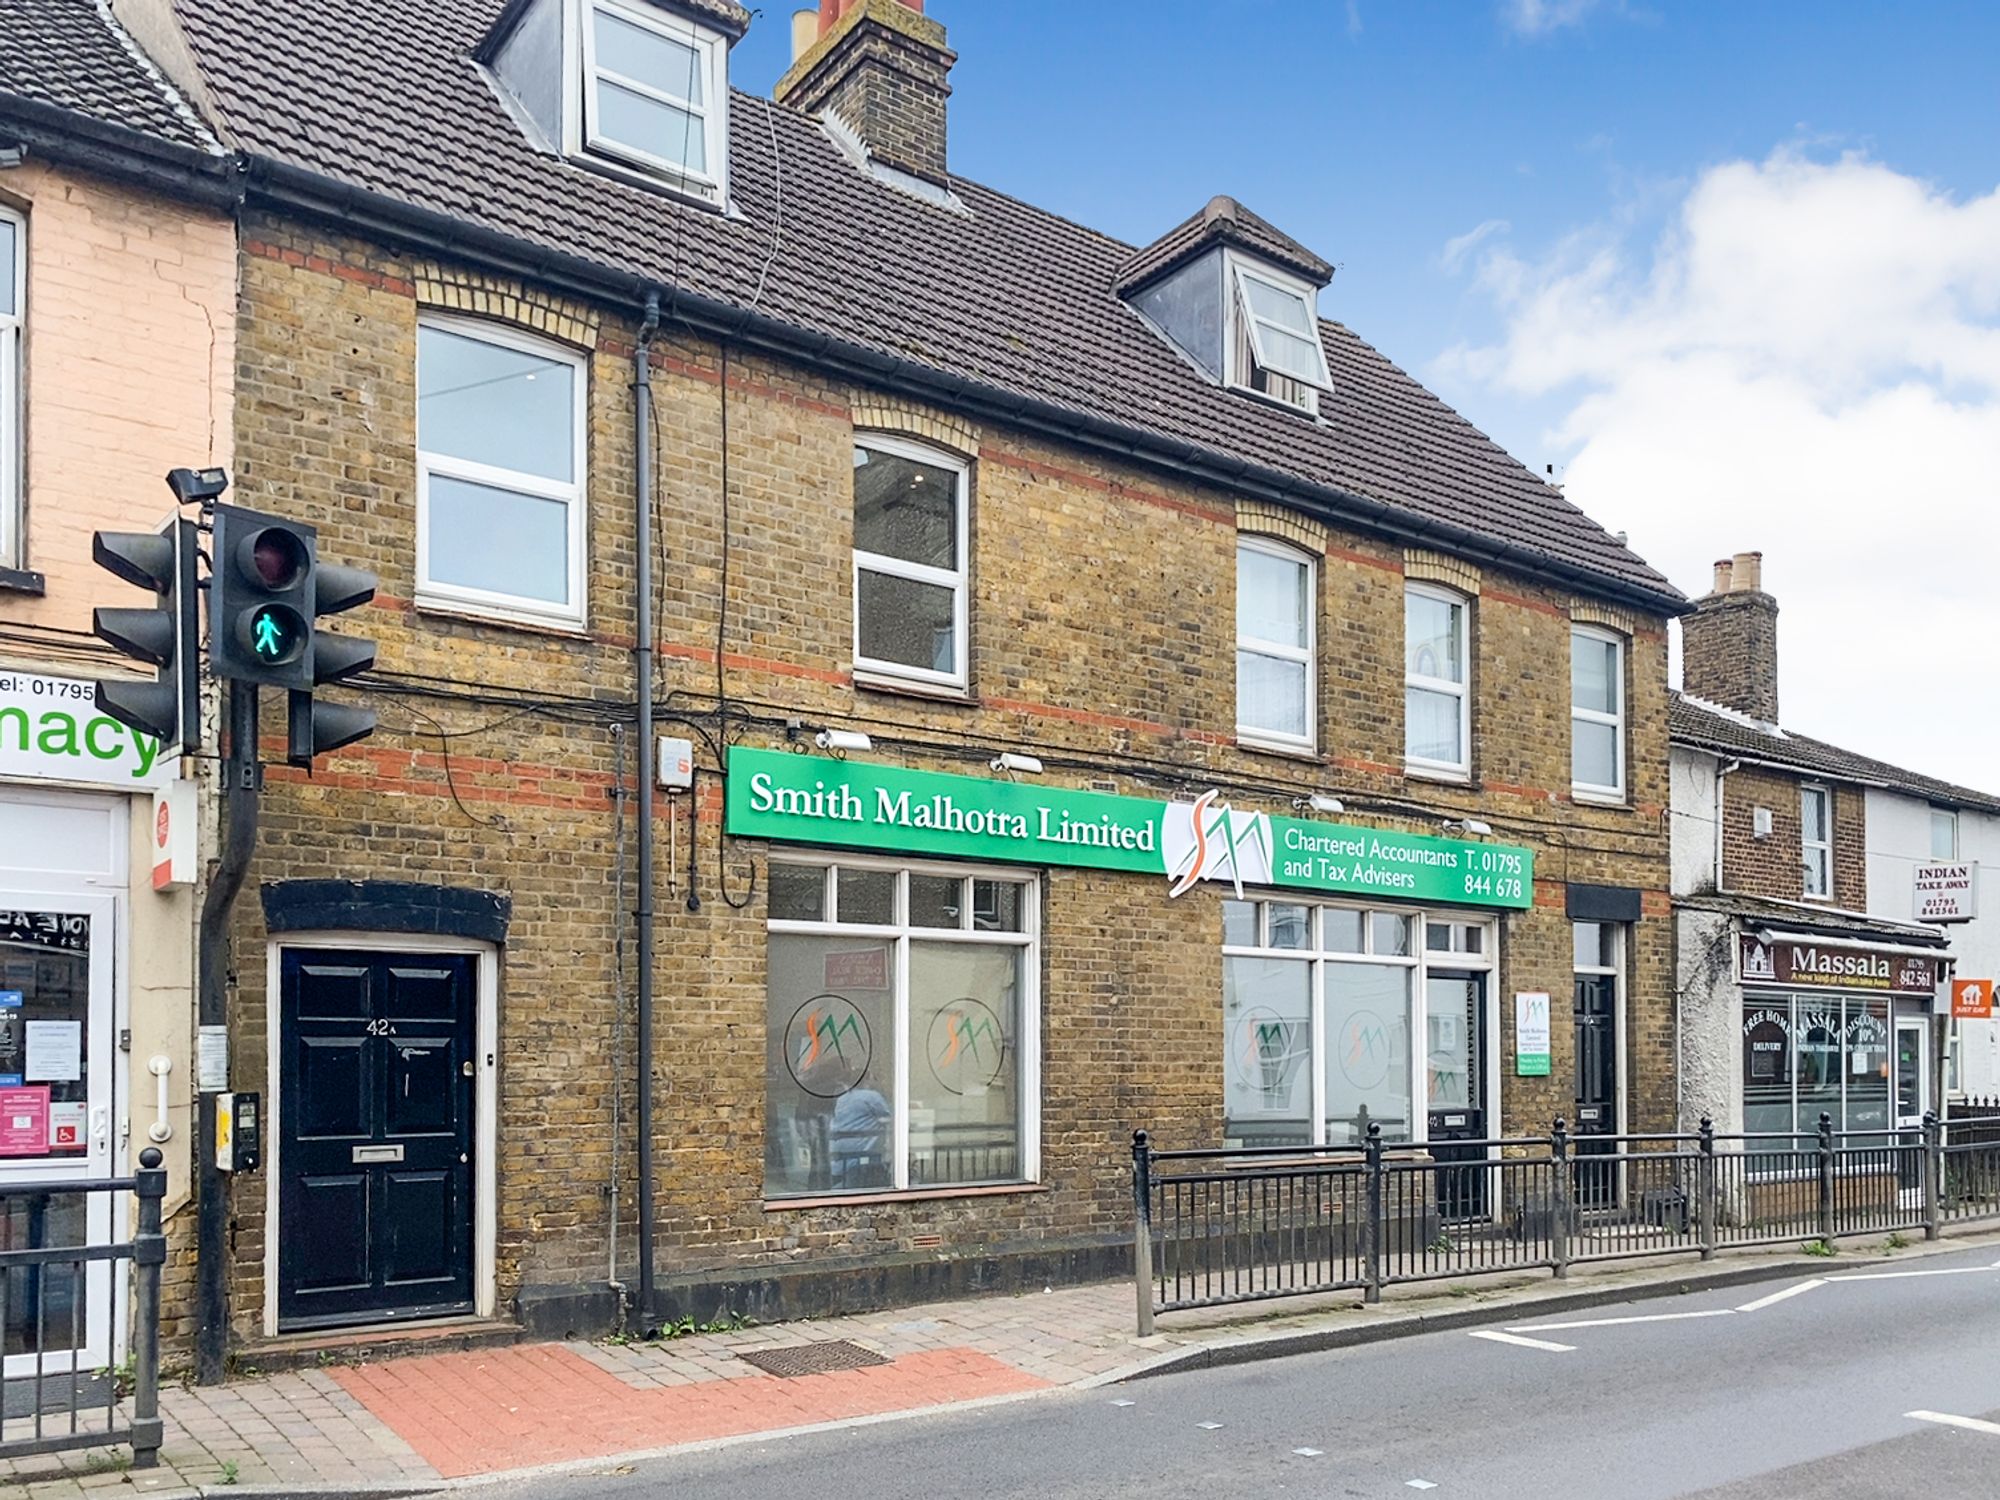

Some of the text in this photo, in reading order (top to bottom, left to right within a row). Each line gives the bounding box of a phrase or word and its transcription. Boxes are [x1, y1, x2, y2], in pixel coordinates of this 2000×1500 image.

[32, 679, 94, 700] 01795
[750, 773, 1155, 852] Smith Malhotra Limited
[1284, 828, 1458, 868] Chartered Accountants
[1283, 858, 1415, 889] and Tax Advisers
[1465, 850, 1522, 875] T. 01795
[1919, 867, 1967, 879] INDIAN
[1464, 874, 1522, 899] 844 678
[1916, 881, 1970, 890] TAKE AWAY
[1791, 946, 1890, 978] Massala
[1743, 1010, 1765, 1036] FREE
